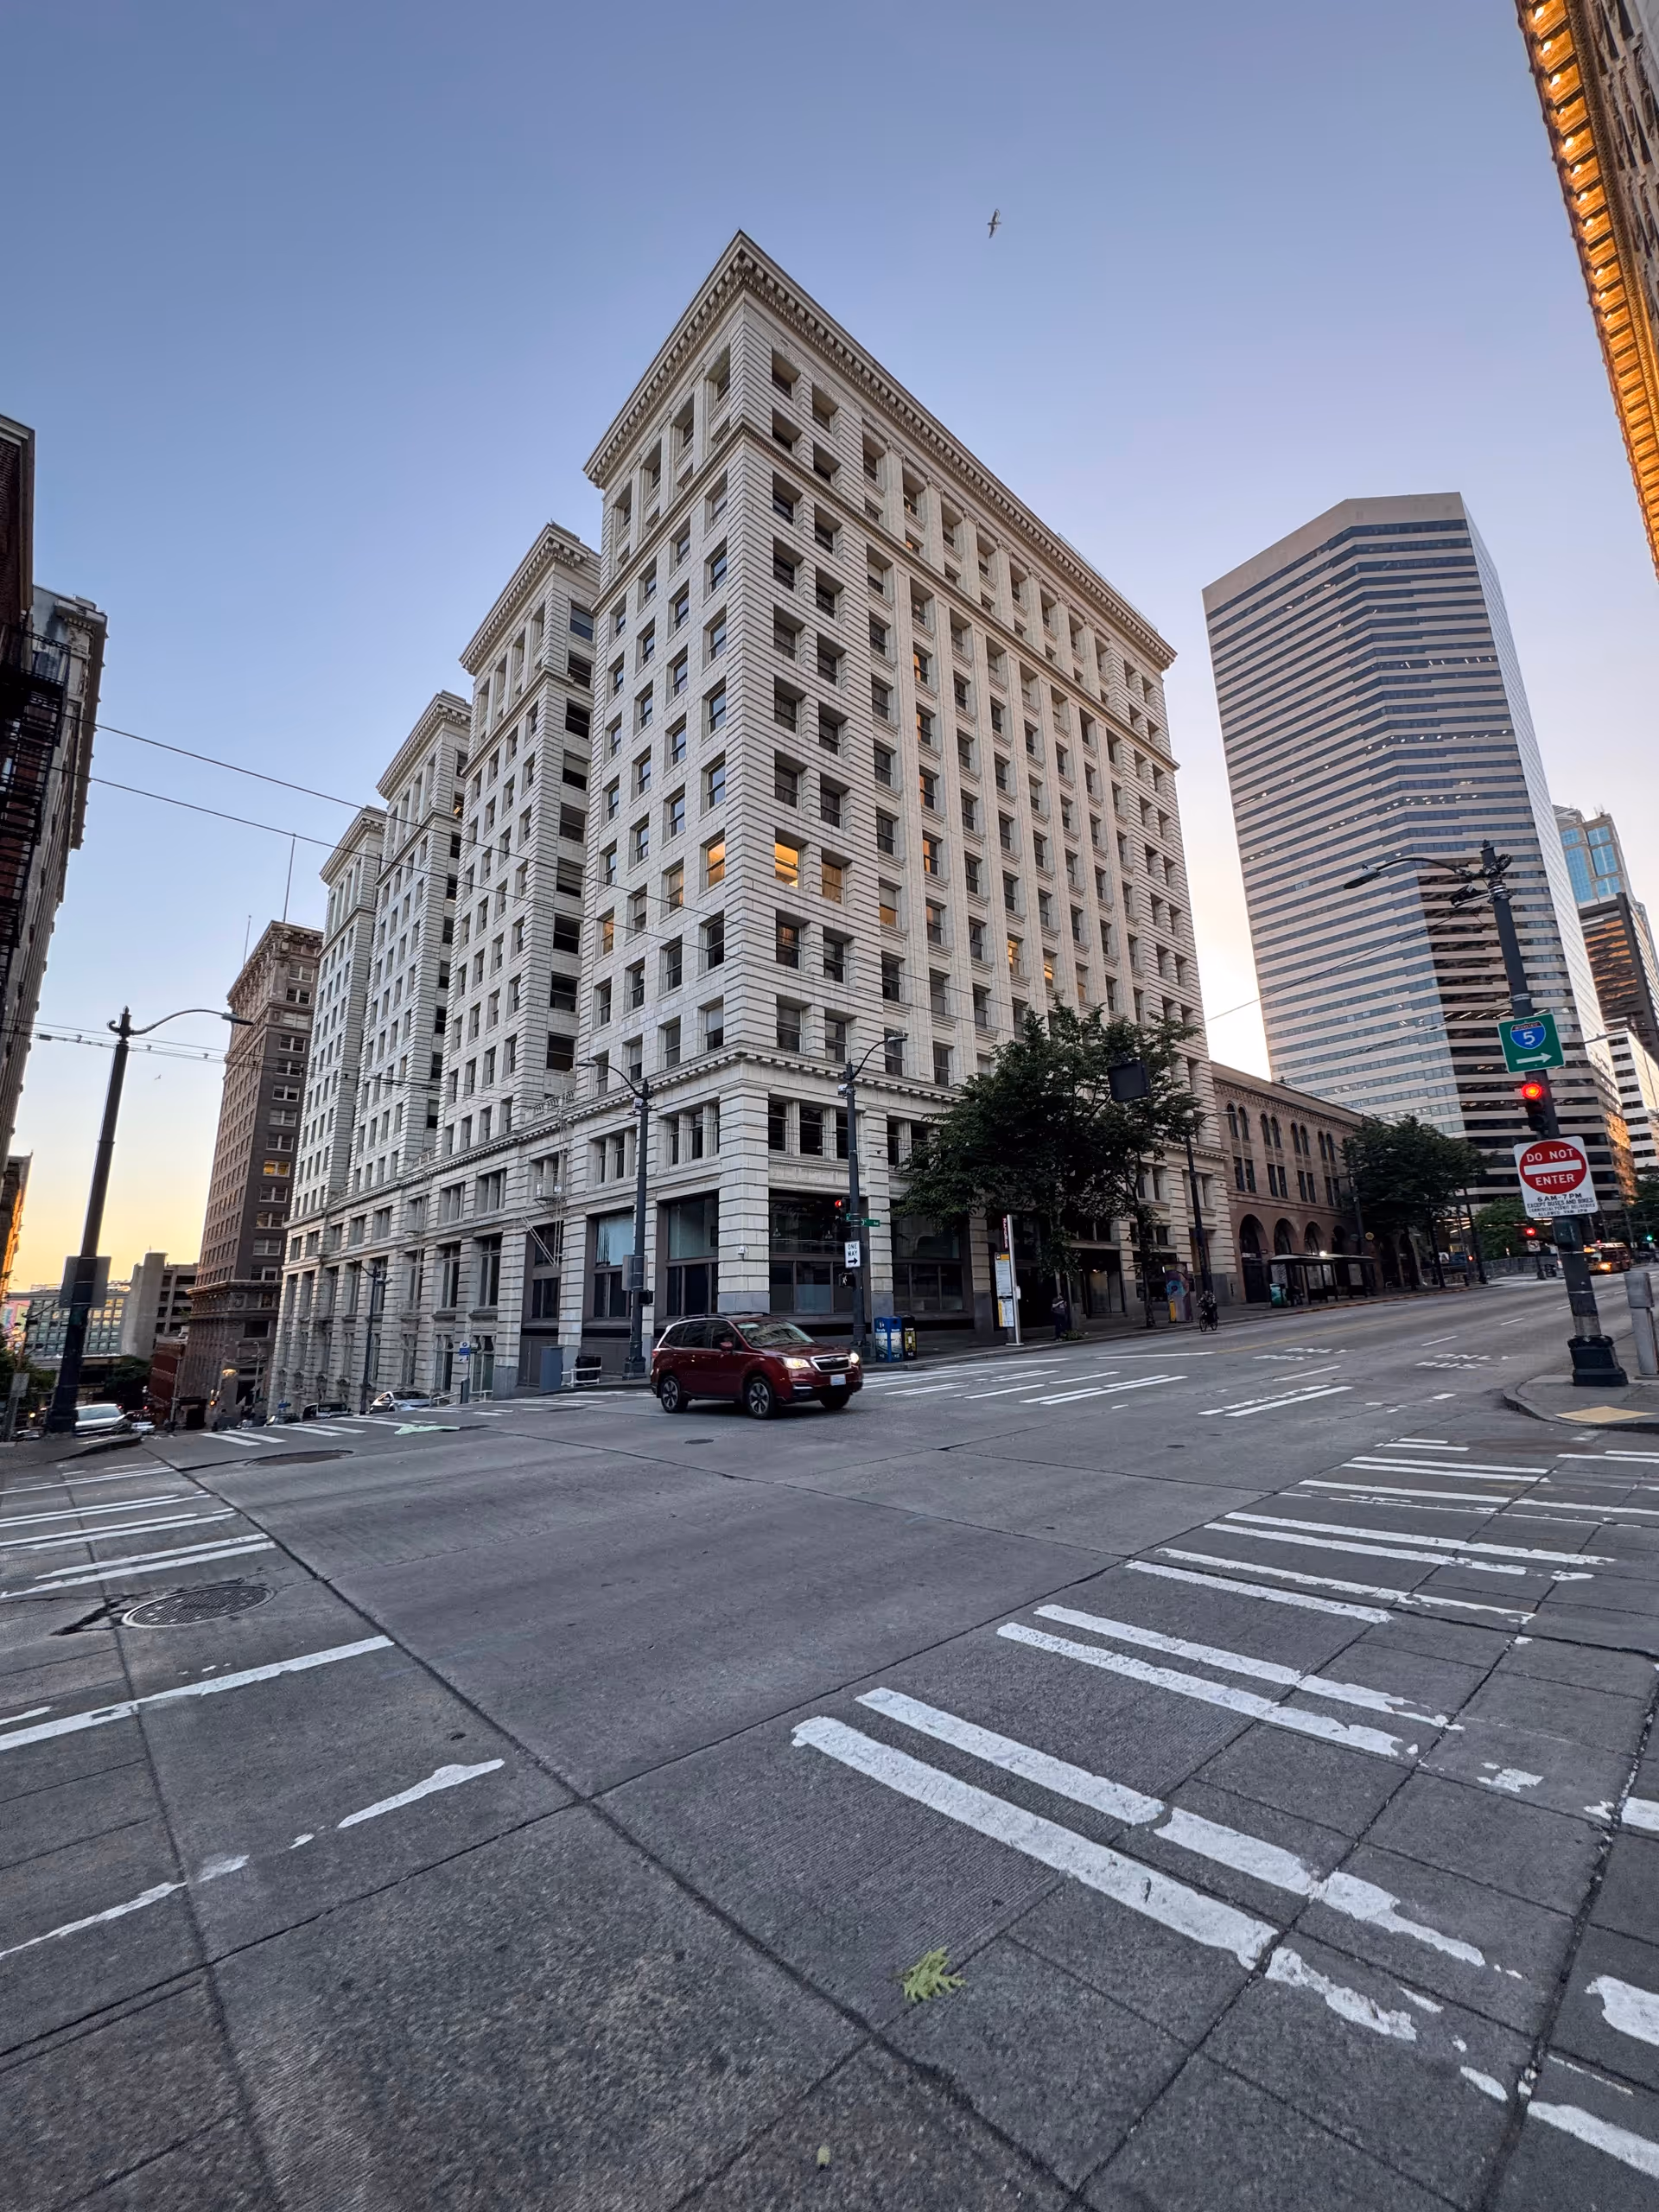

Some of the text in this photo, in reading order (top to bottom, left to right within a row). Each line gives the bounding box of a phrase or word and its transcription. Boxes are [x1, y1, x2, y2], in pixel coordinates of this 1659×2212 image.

[1522, 1031, 1535, 1046] 5
[1526, 1148, 1574, 1163] DO NOT
[1535, 1173, 1575, 1186] ENTER
[1414, 1361, 1484, 1370] BUS
